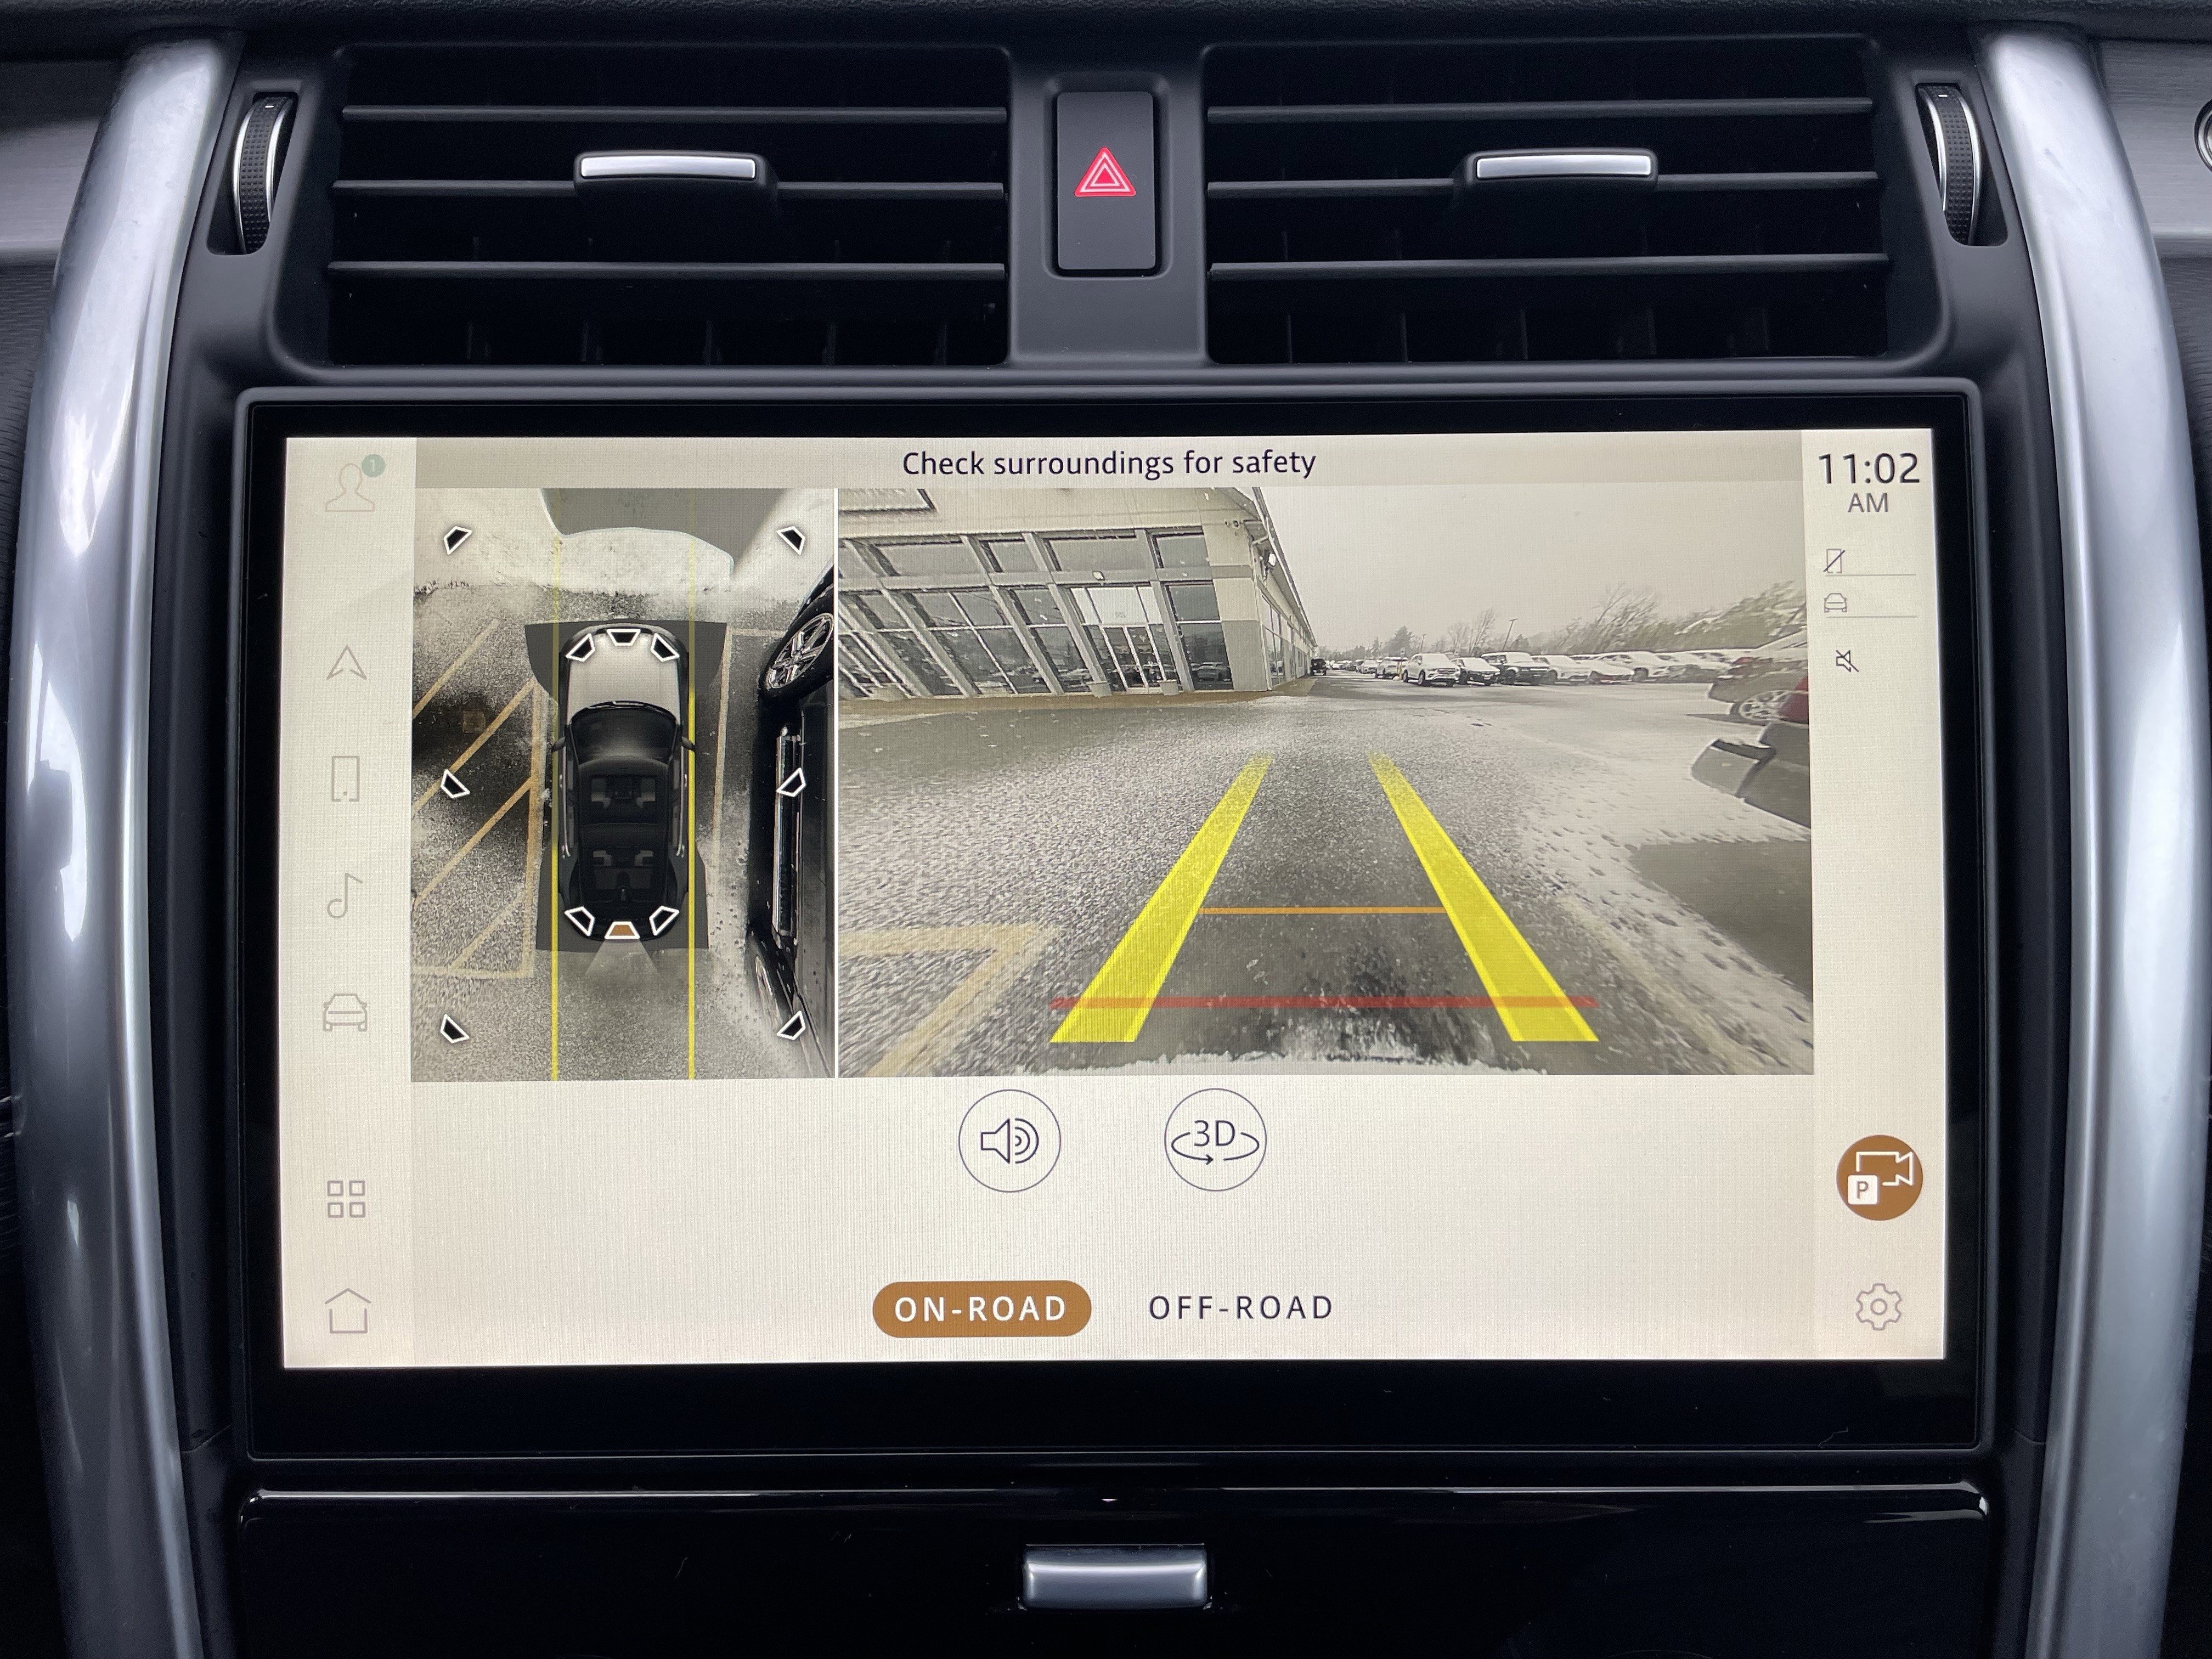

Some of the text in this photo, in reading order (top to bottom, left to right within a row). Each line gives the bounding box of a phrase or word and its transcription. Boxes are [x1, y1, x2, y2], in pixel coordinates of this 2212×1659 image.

[903, 449, 1316, 481] Check surroundings for safety
[1819, 453, 1921, 484] 11:02
[1848, 493, 1889, 513] AM
[1194, 1120, 1235, 1147] 3D
[1856, 1181, 1869, 1199] P
[895, 1296, 1065, 1322] ON-ROAD
[1149, 1295, 1333, 1320] OFF-ROAD
